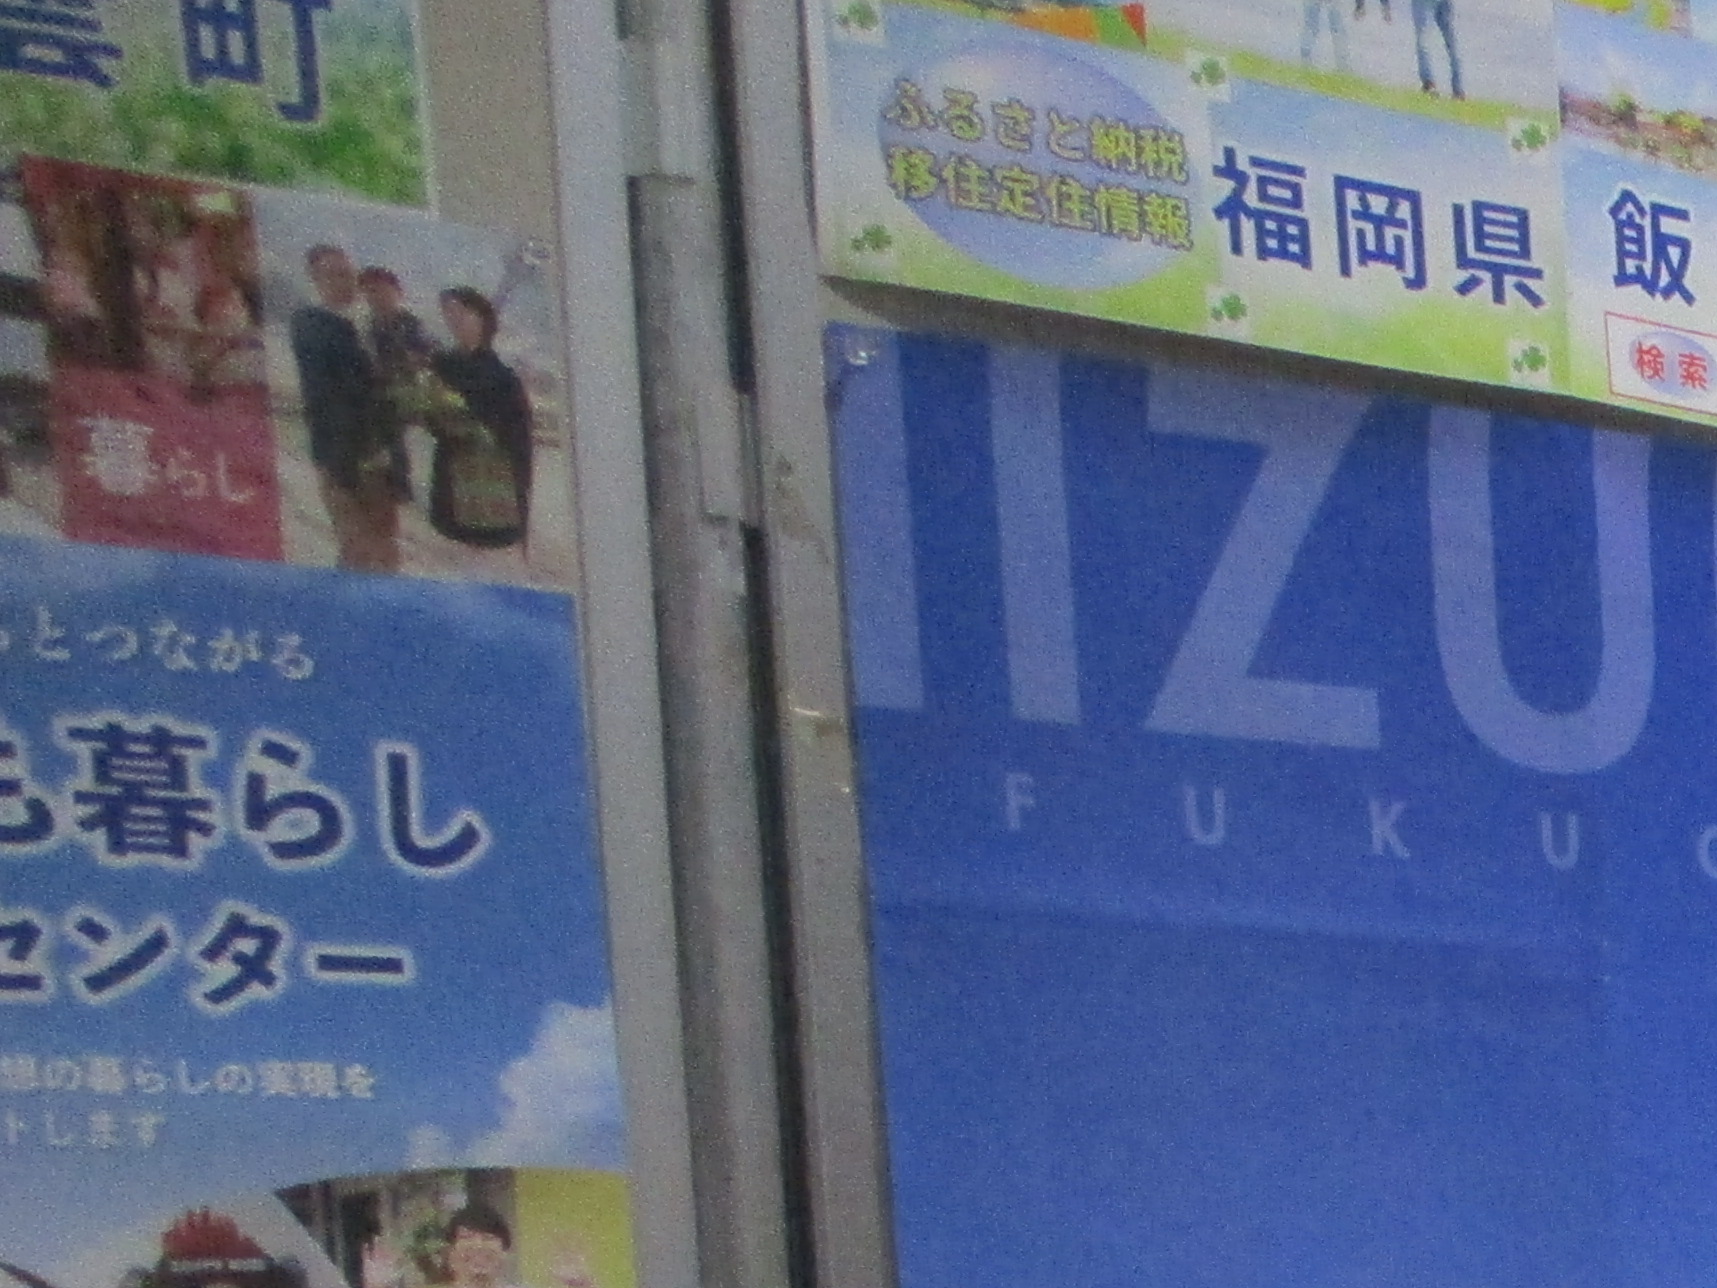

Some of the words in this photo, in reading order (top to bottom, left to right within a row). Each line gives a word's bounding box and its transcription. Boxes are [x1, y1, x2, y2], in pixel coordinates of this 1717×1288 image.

[882, 78, 1190, 186] ふるさと納税
[886, 145, 1195, 252] 移住定住情報
[1212, 145, 1547, 310] 福岡県
[1632, 339, 1709, 390] 検索
[0, 605, 316, 682] とつながる
[0, 908, 408, 1006] センター
